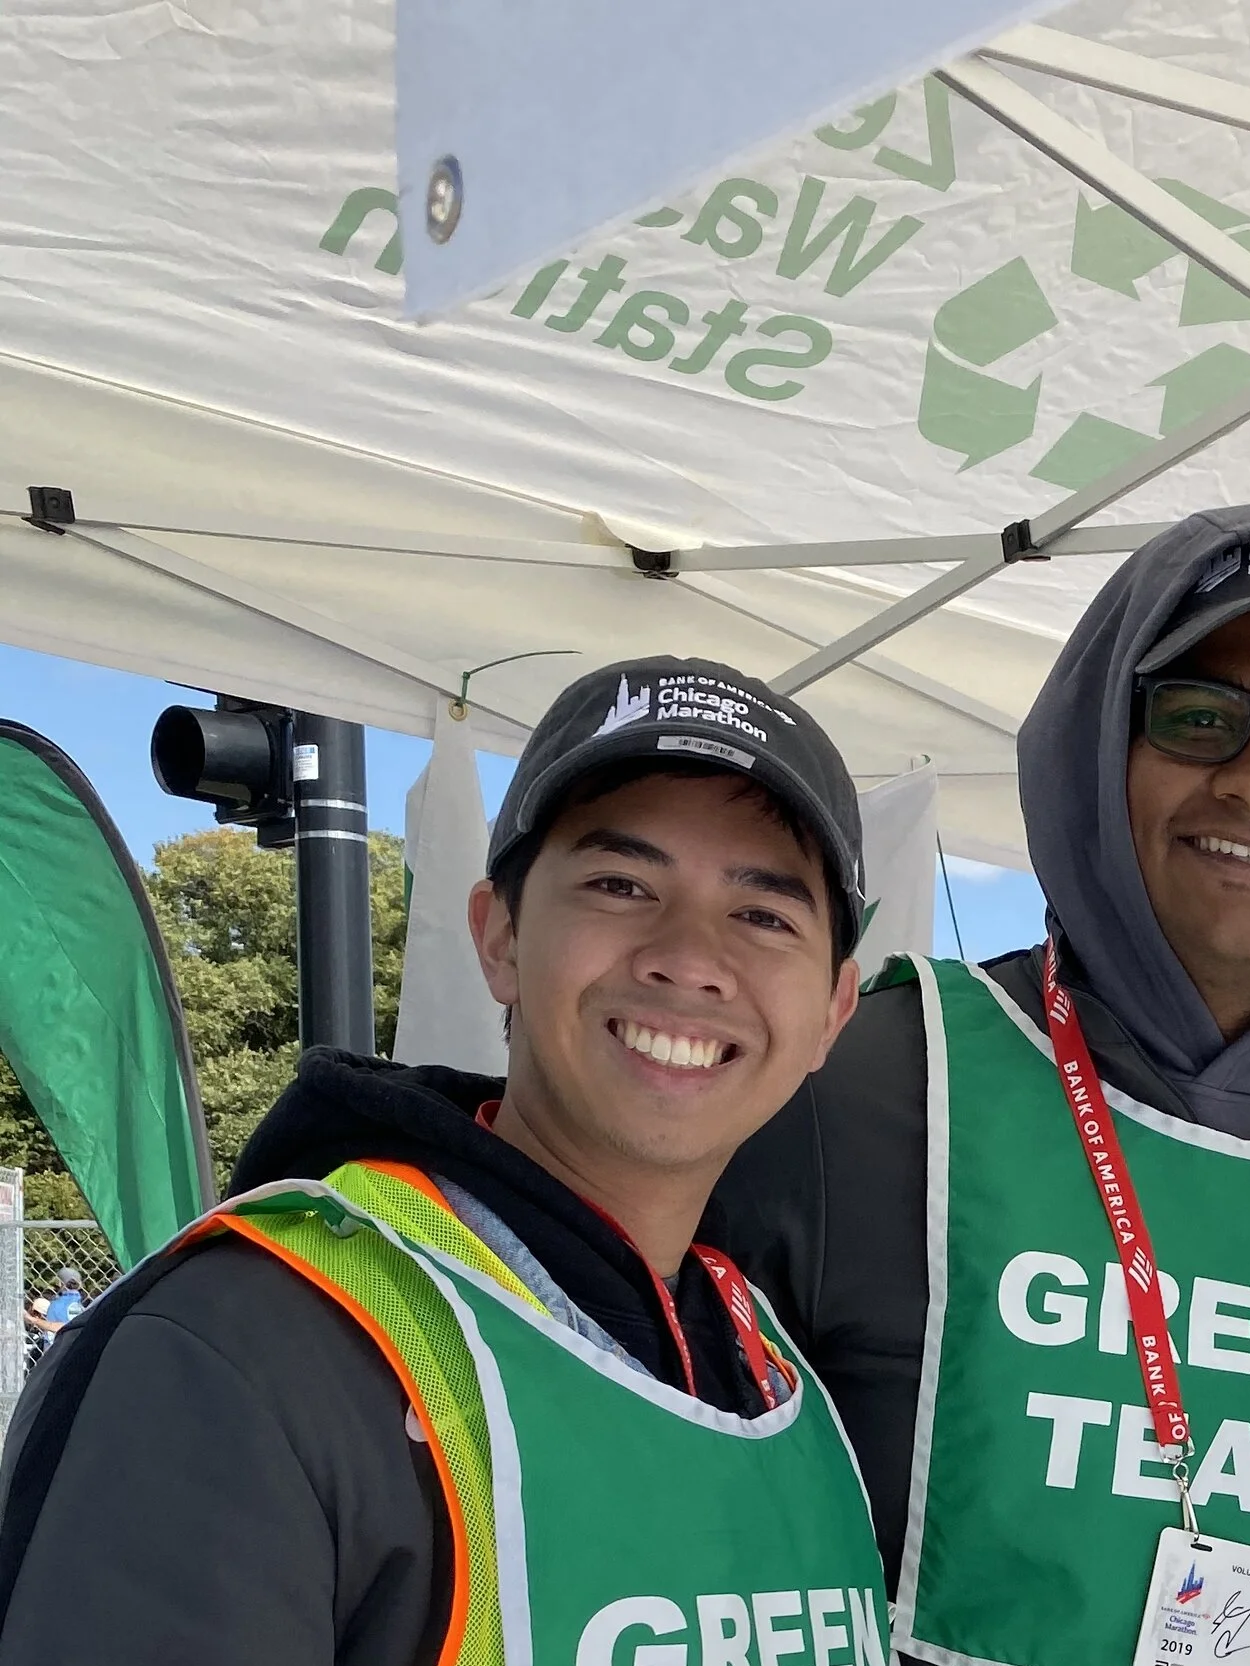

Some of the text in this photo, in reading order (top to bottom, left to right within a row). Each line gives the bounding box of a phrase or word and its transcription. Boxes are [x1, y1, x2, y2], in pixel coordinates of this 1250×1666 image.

[657, 687, 749, 715] Chicago
[658, 675, 773, 712] BANK OF AMERICA
[656, 703, 767, 742] Marathon
[1063, 1059, 1136, 1246] BANK OF AMERICA
[1141, 1335, 1167, 1397] BANK
[1164, 1622, 1197, 1636] Marathon
[1169, 1615, 1196, 1628] Chicago
[1160, 1638, 1193, 1656] 2019
